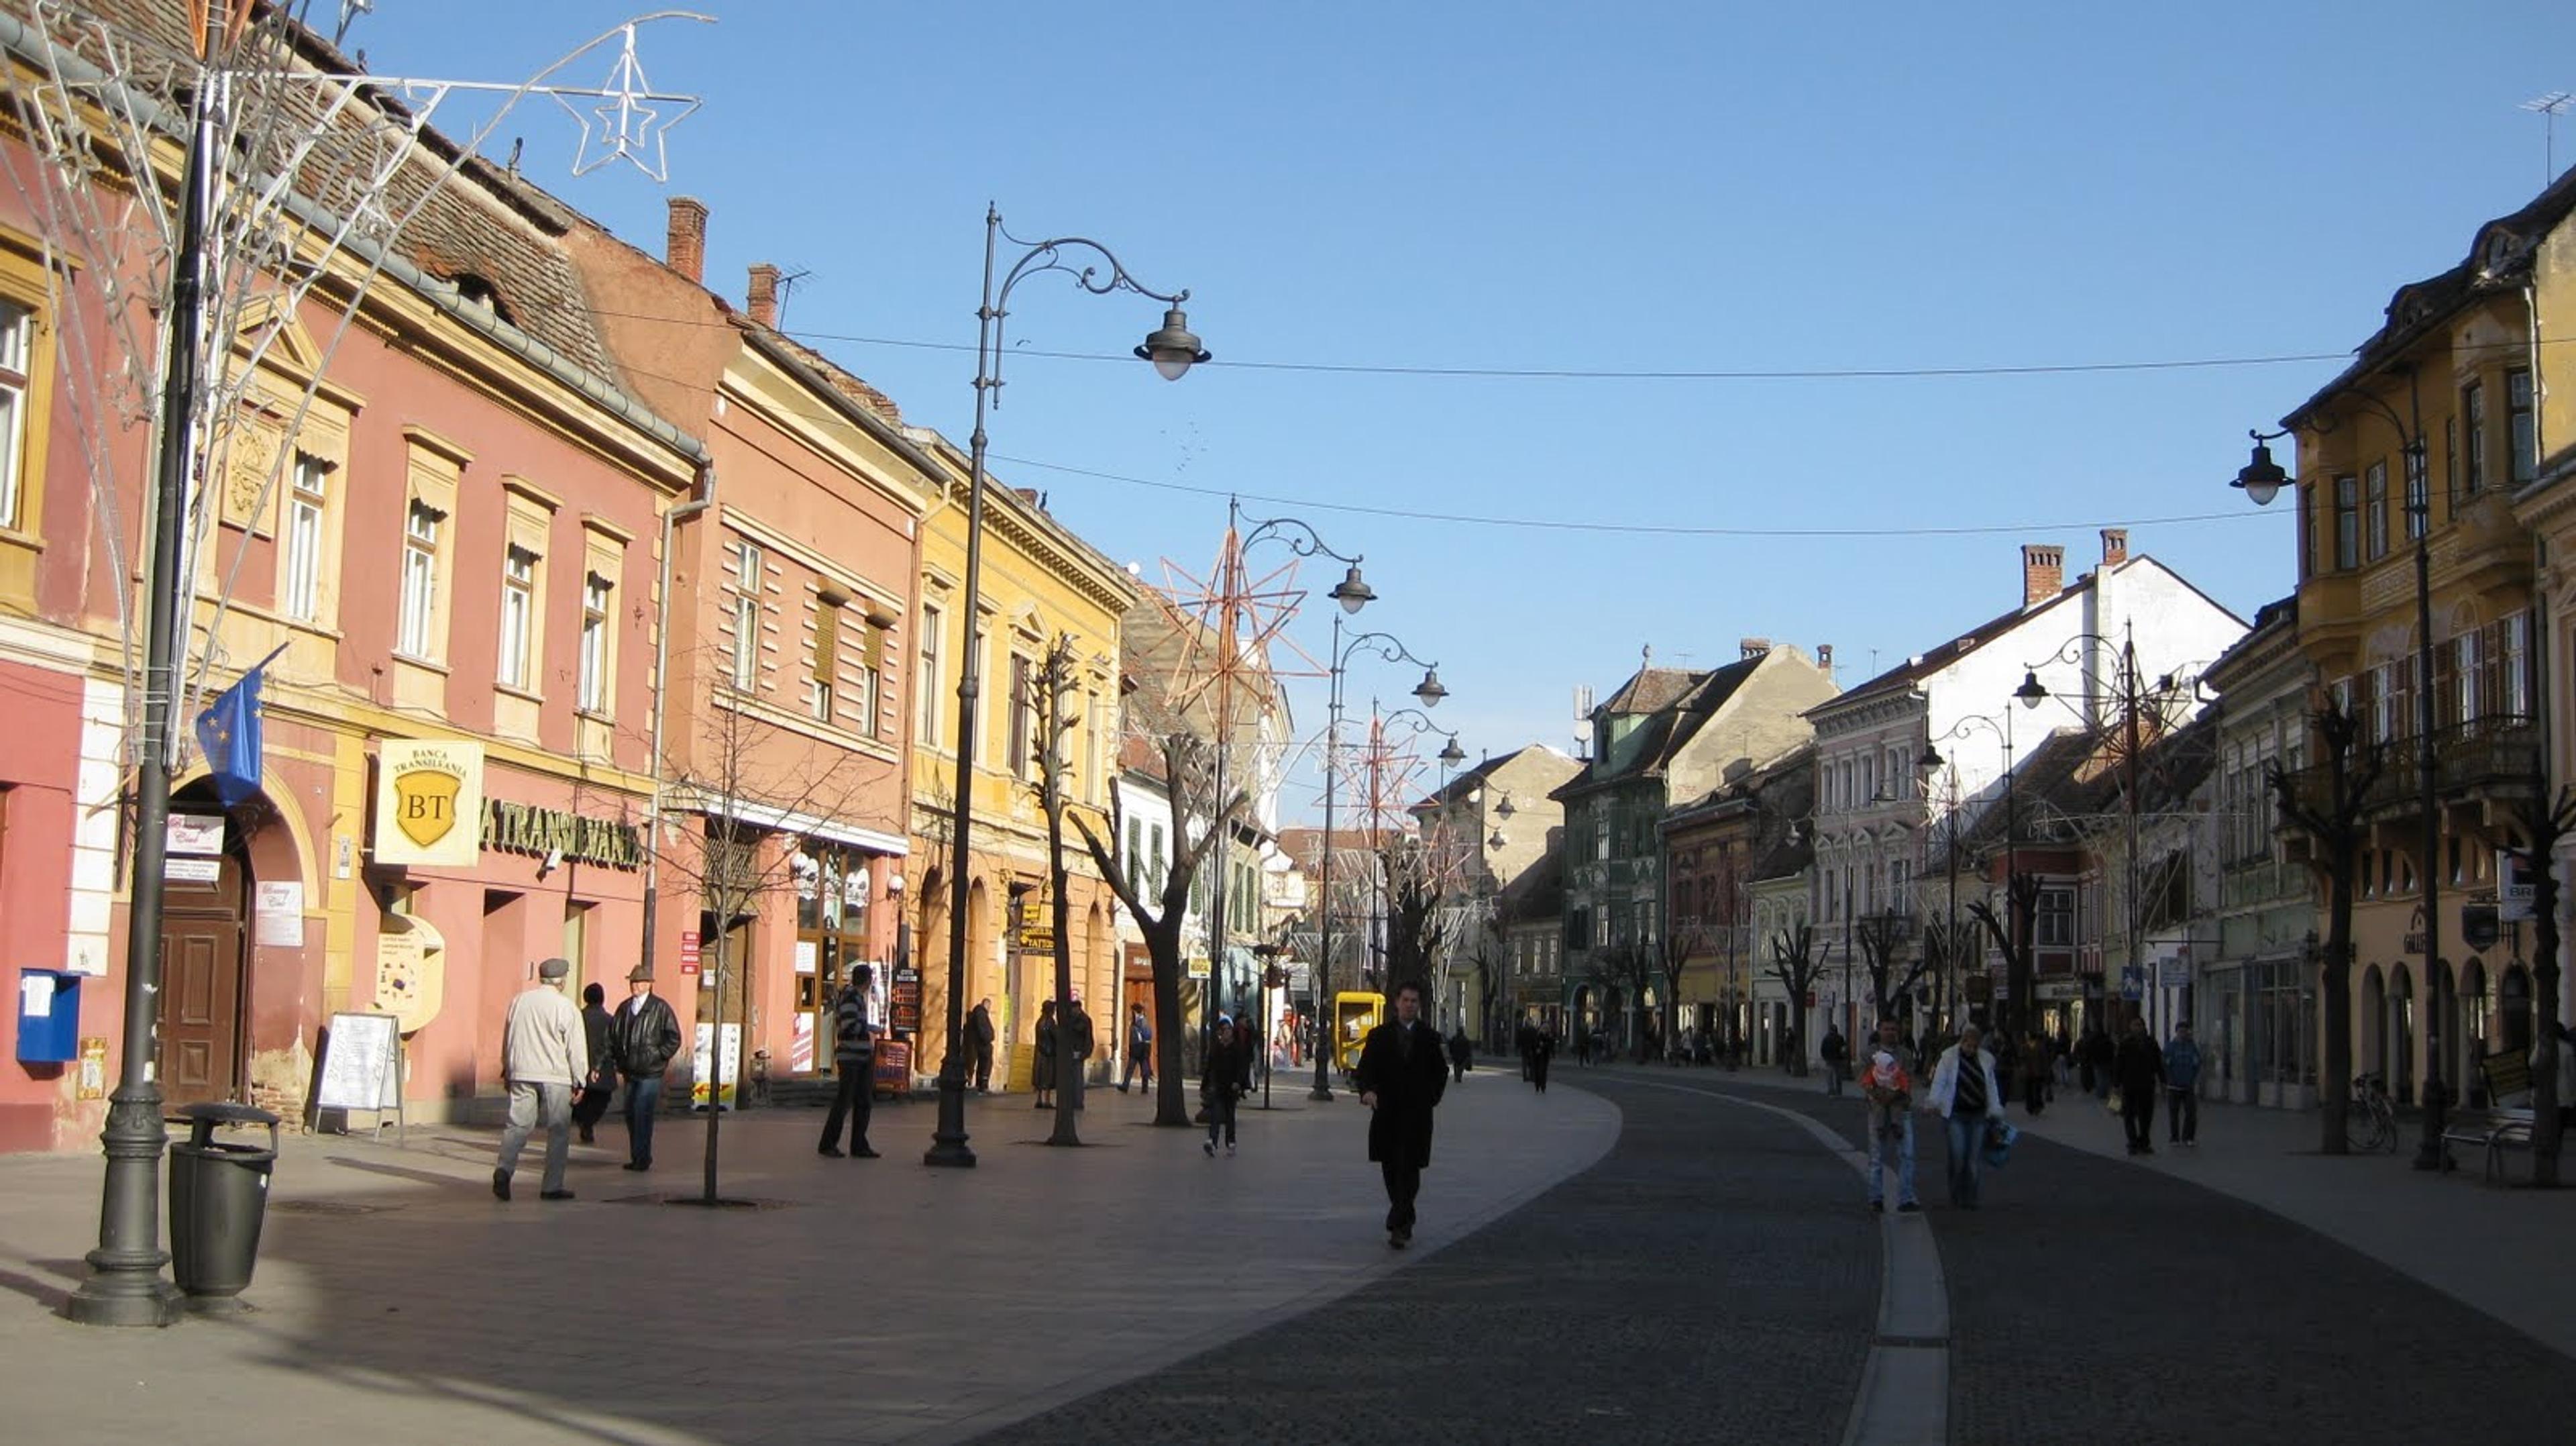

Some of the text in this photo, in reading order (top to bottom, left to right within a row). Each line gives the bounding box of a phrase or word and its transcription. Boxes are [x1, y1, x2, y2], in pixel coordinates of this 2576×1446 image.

[412, 750, 448, 760] BANCA
[393, 758, 467, 778] TRANSILVANIA
[407, 794, 449, 819] BT
